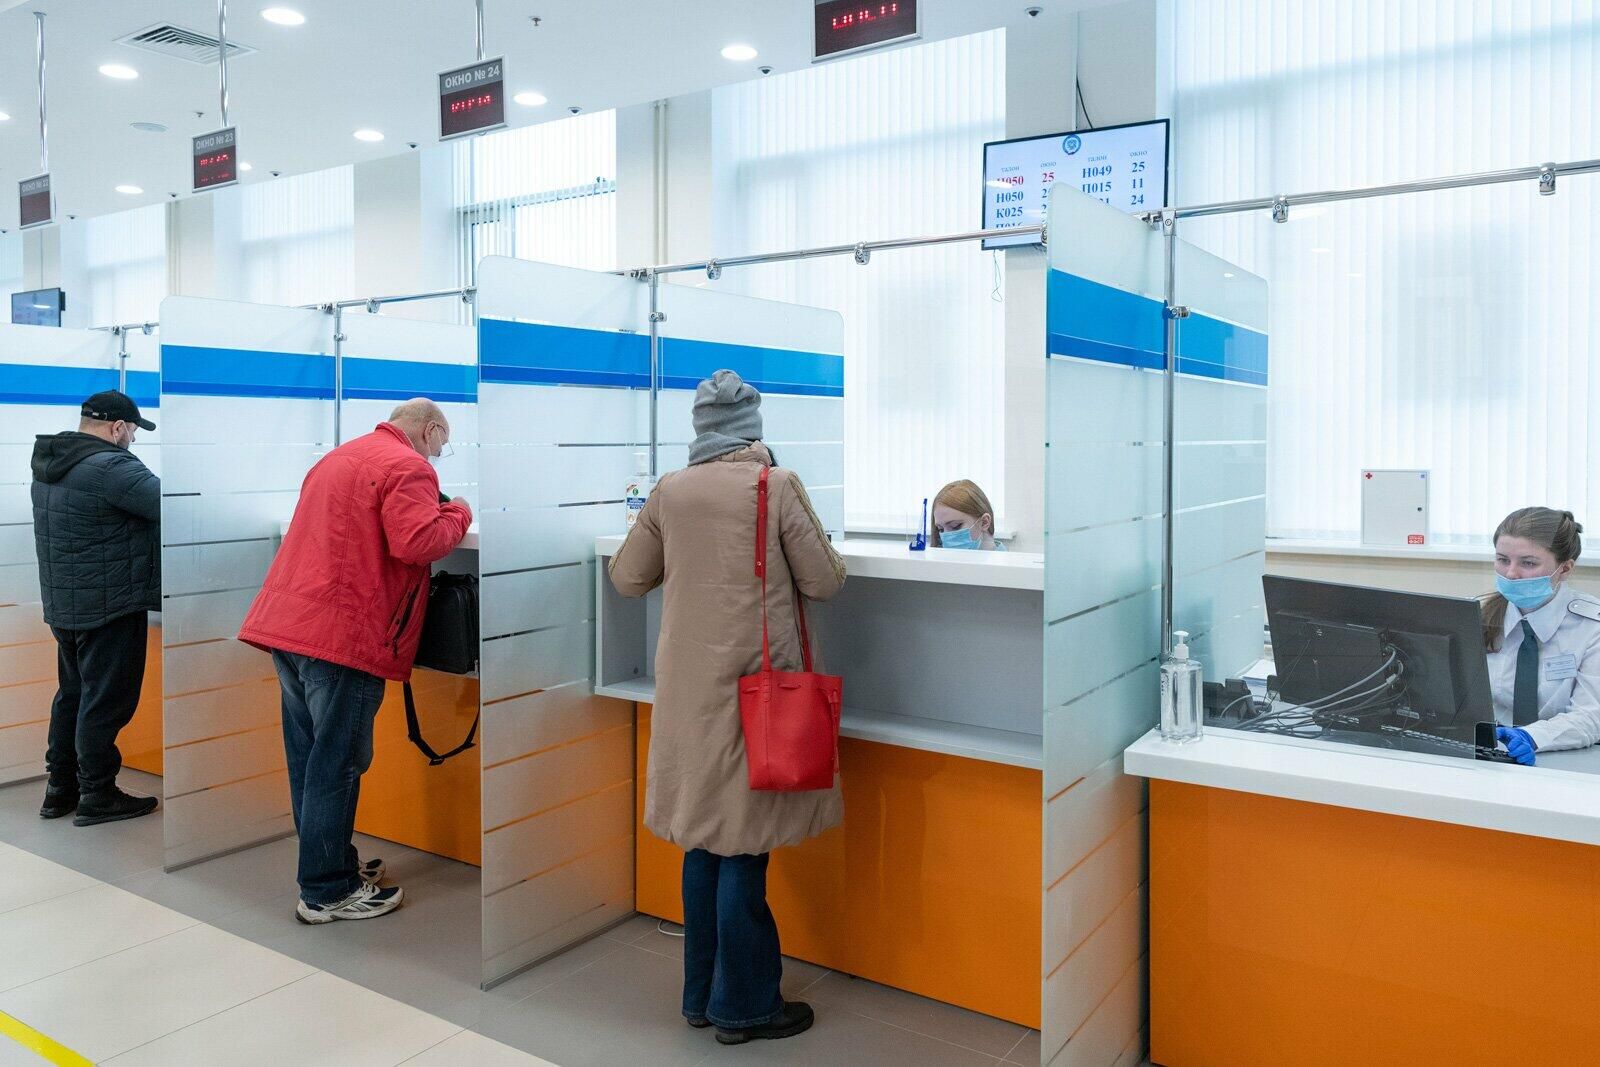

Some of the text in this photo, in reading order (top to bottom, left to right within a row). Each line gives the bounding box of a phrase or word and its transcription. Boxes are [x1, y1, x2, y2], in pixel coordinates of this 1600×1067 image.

[445, 65, 500, 88] ОКНО № 24
[196, 132, 234, 149] ОКНО № 23
[1082, 161, 1145, 178] Н049 25
[1042, 171, 1055, 182] 25
[1082, 178, 1143, 193] П015 11
[996, 191, 1024, 203] Н050
[1131, 194, 1144, 205] 24
[996, 206, 1023, 218] К025
